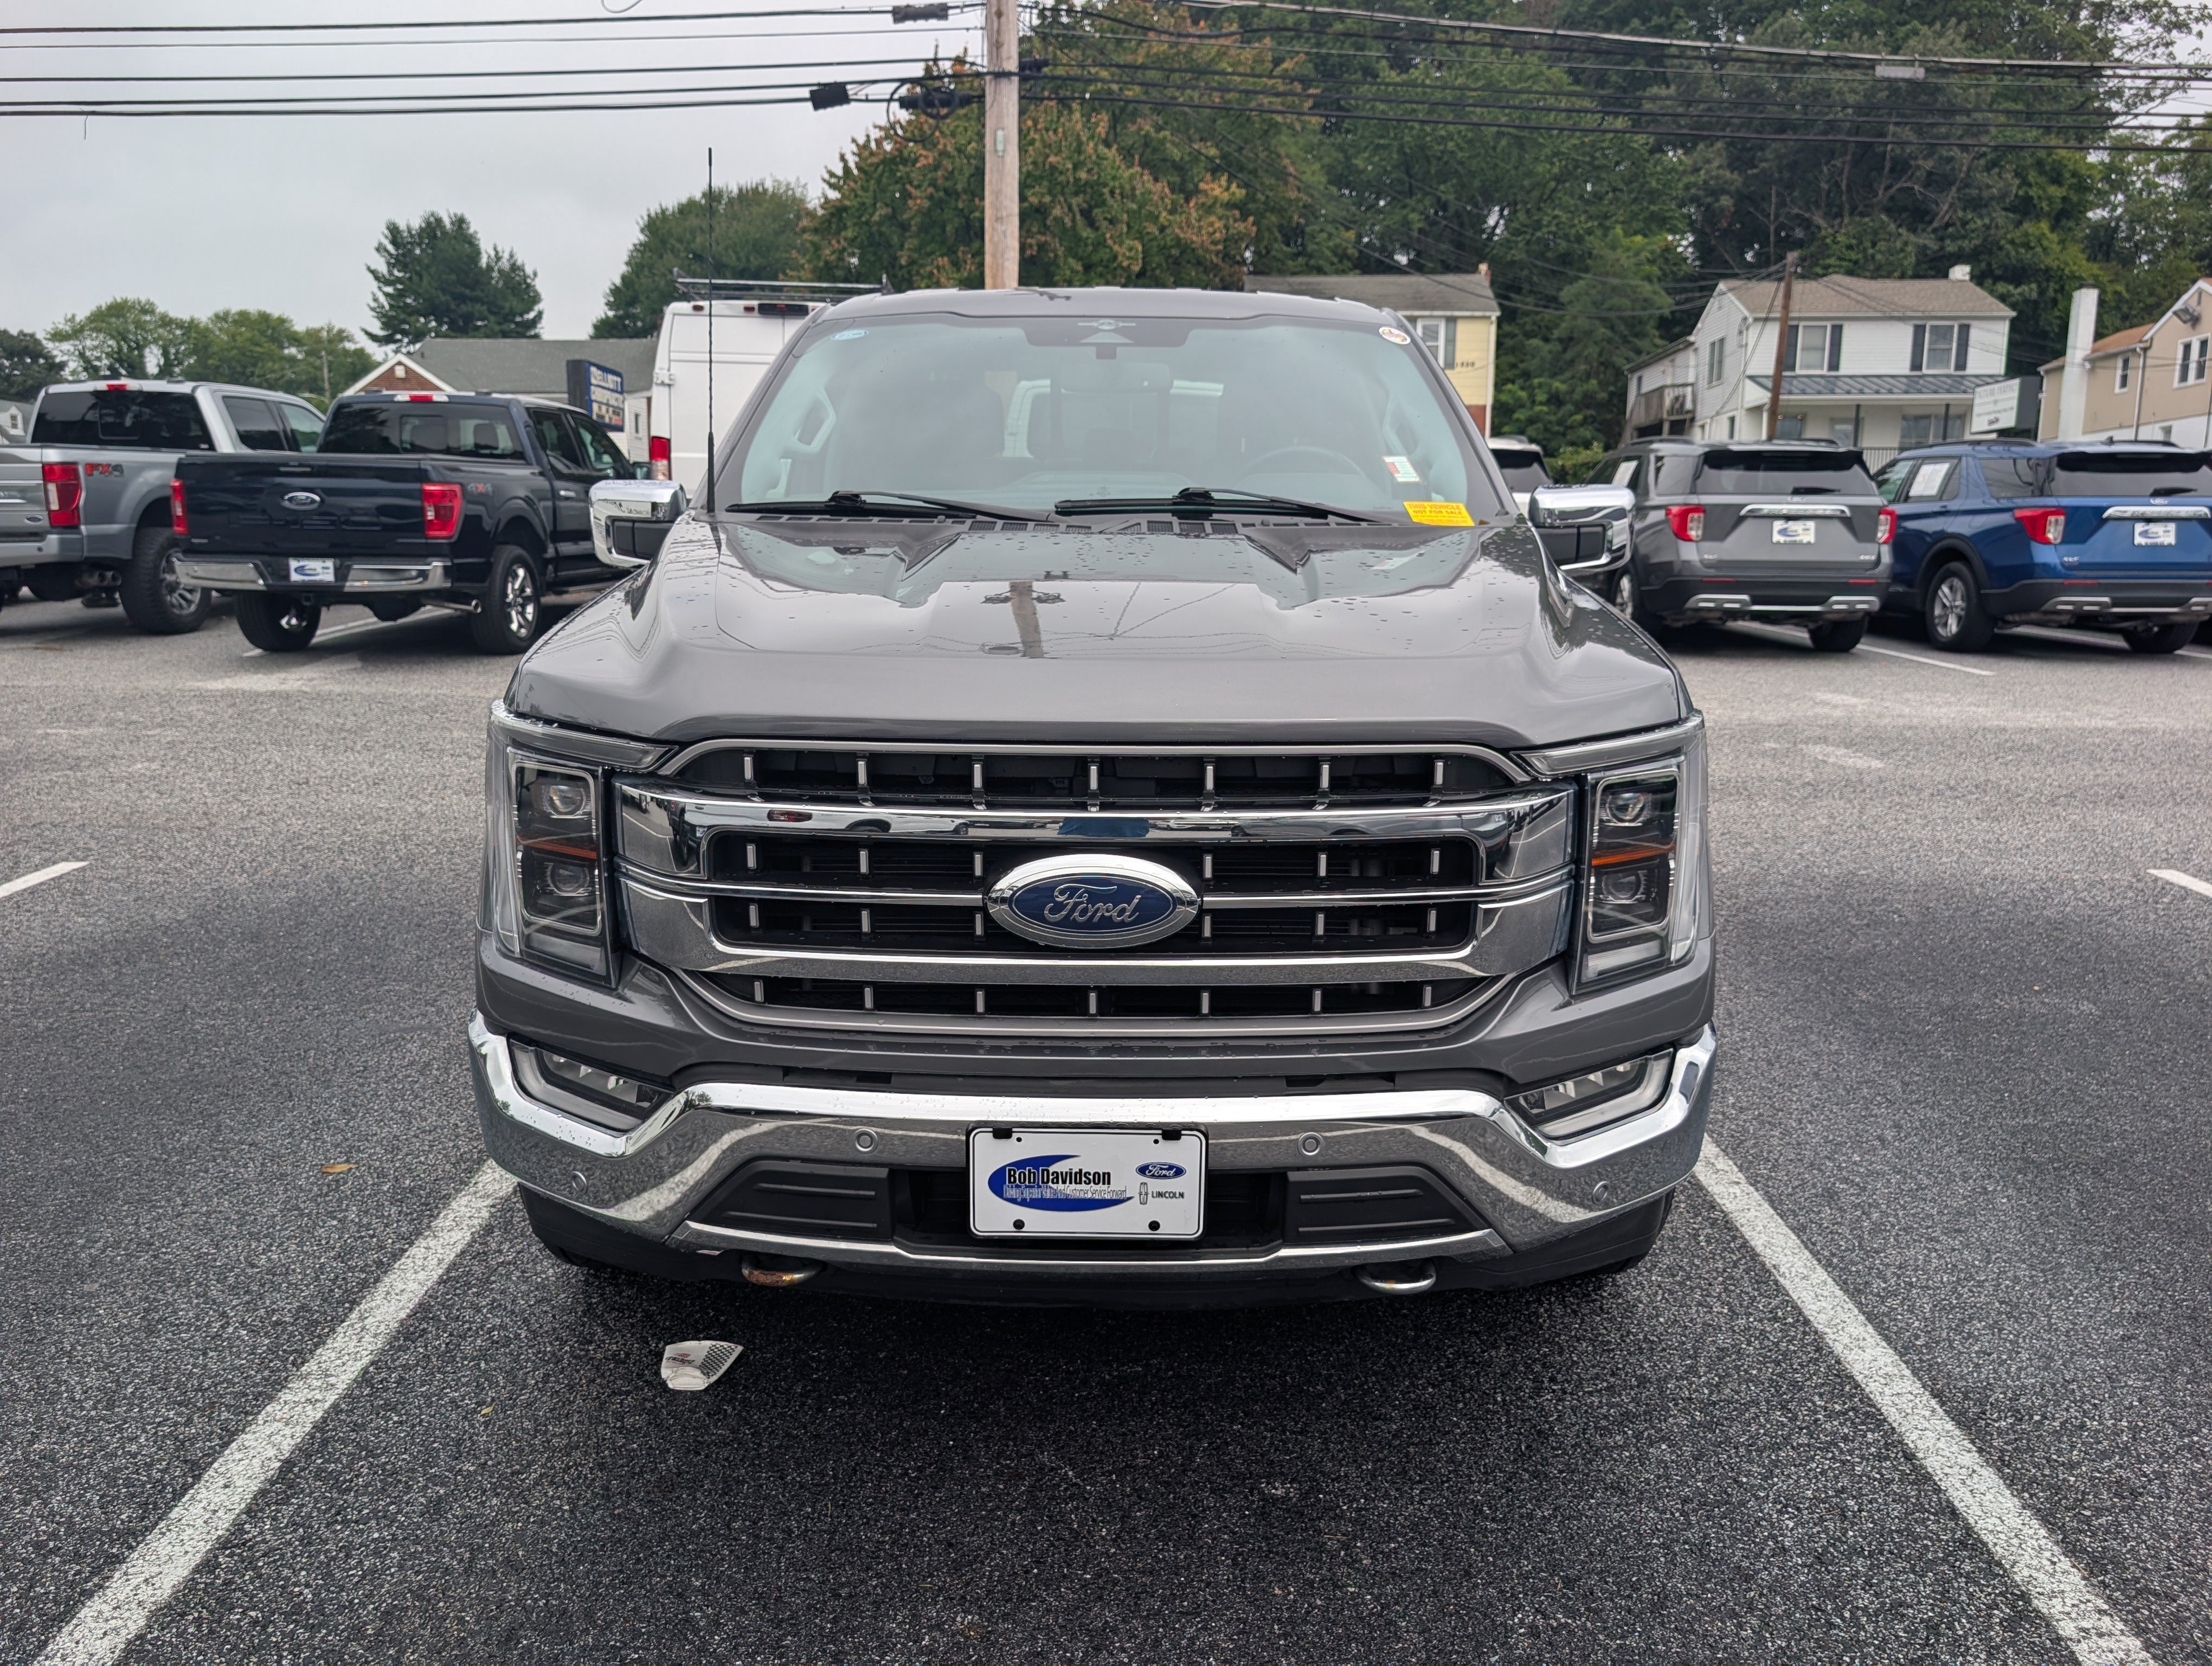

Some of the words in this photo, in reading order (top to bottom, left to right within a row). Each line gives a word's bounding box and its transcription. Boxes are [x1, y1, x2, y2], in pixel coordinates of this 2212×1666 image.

[85, 463, 124, 477] FX4
[1044, 883, 1142, 923] Ford
[1007, 1167, 1037, 1186] Bob
[1040, 1167, 1111, 1186] Davidson
[1145, 1164, 1176, 1177] Ford
[1066, 1186, 1089, 1199] Customer
[1090, 1186, 1106, 1199] Service
[1107, 1186, 1127, 1199] Forward
[1151, 1190, 1185, 1199] LINCOLN
